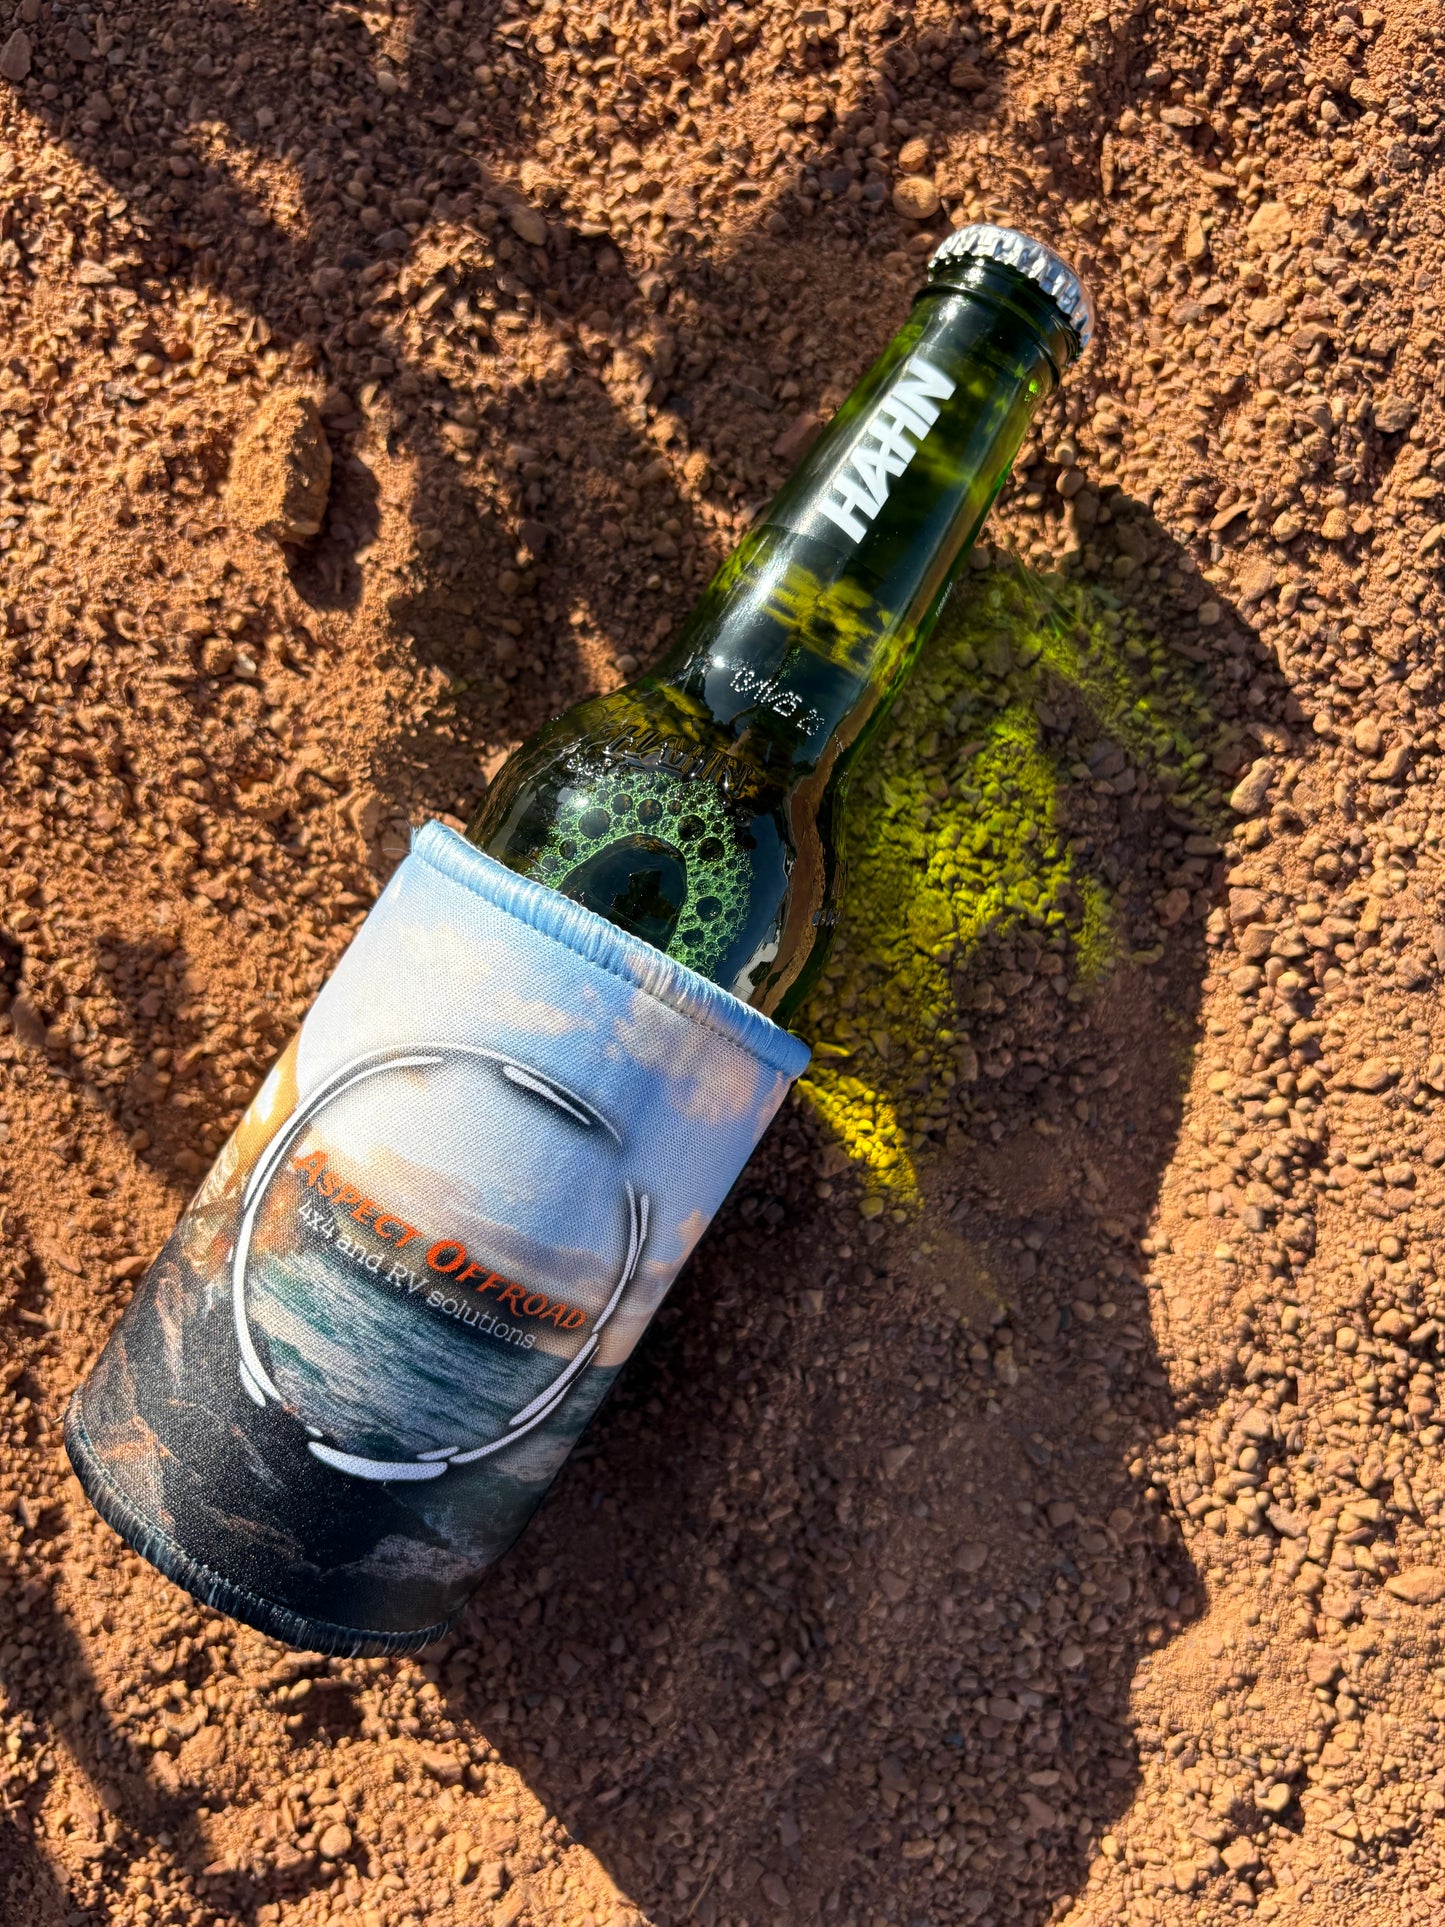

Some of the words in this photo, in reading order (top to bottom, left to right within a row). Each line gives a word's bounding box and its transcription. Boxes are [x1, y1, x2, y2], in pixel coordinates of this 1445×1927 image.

[818, 357, 956, 544] HAHN
[292, 1149, 425, 1249] ASPECT
[425, 1239, 587, 1330] OFFROAD
[297, 1200, 337, 1240] 4x4
[335, 1233, 386, 1273] and
[385, 1262, 431, 1295] RV
[426, 1289, 538, 1350] solutions
